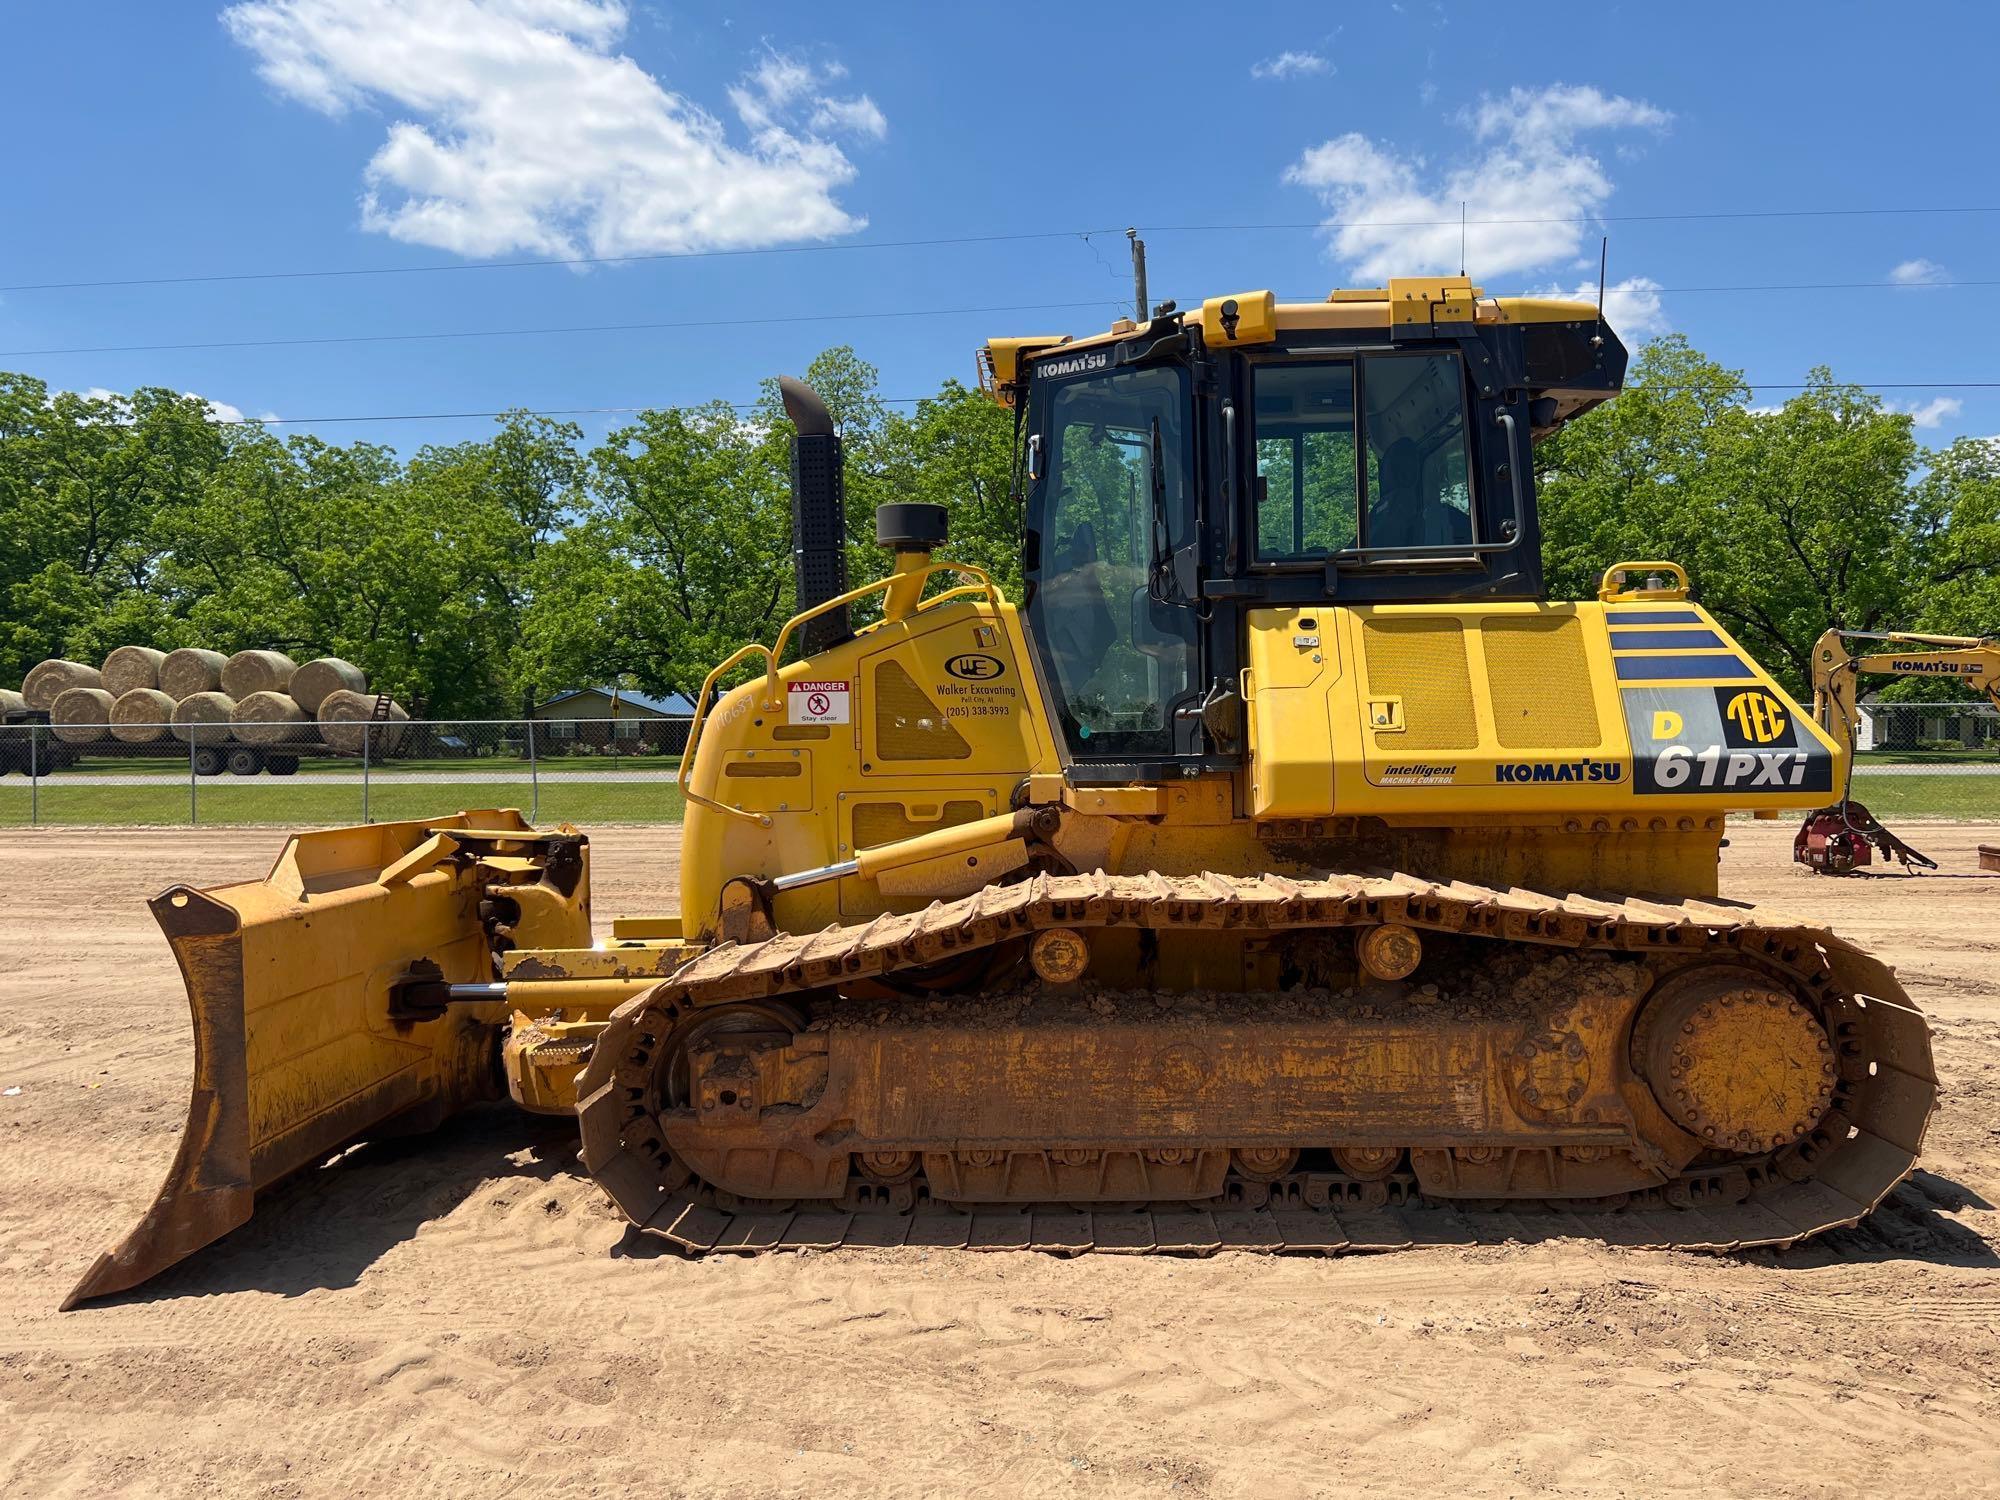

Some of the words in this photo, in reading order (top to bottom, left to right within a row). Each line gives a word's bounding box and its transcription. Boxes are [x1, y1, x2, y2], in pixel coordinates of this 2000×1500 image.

[1037, 354, 1107, 379] KOMATSU
[1892, 660, 1959, 673] KOMATSU
[802, 682, 846, 692] DANGER
[936, 683, 968, 696] Walker
[970, 684, 1016, 698] Excavating
[801, 715, 817, 723] Stay
[946, 706, 969, 719] (205)
[971, 706, 1009, 716] 338-3993
[1652, 711, 1683, 740] D
[1384, 765, 1457, 777] intelligent
[1495, 758, 1621, 783] KOMATSU
[1379, 776, 1417, 784] MACHINE
[1417, 776, 1454, 784] CONTROL
